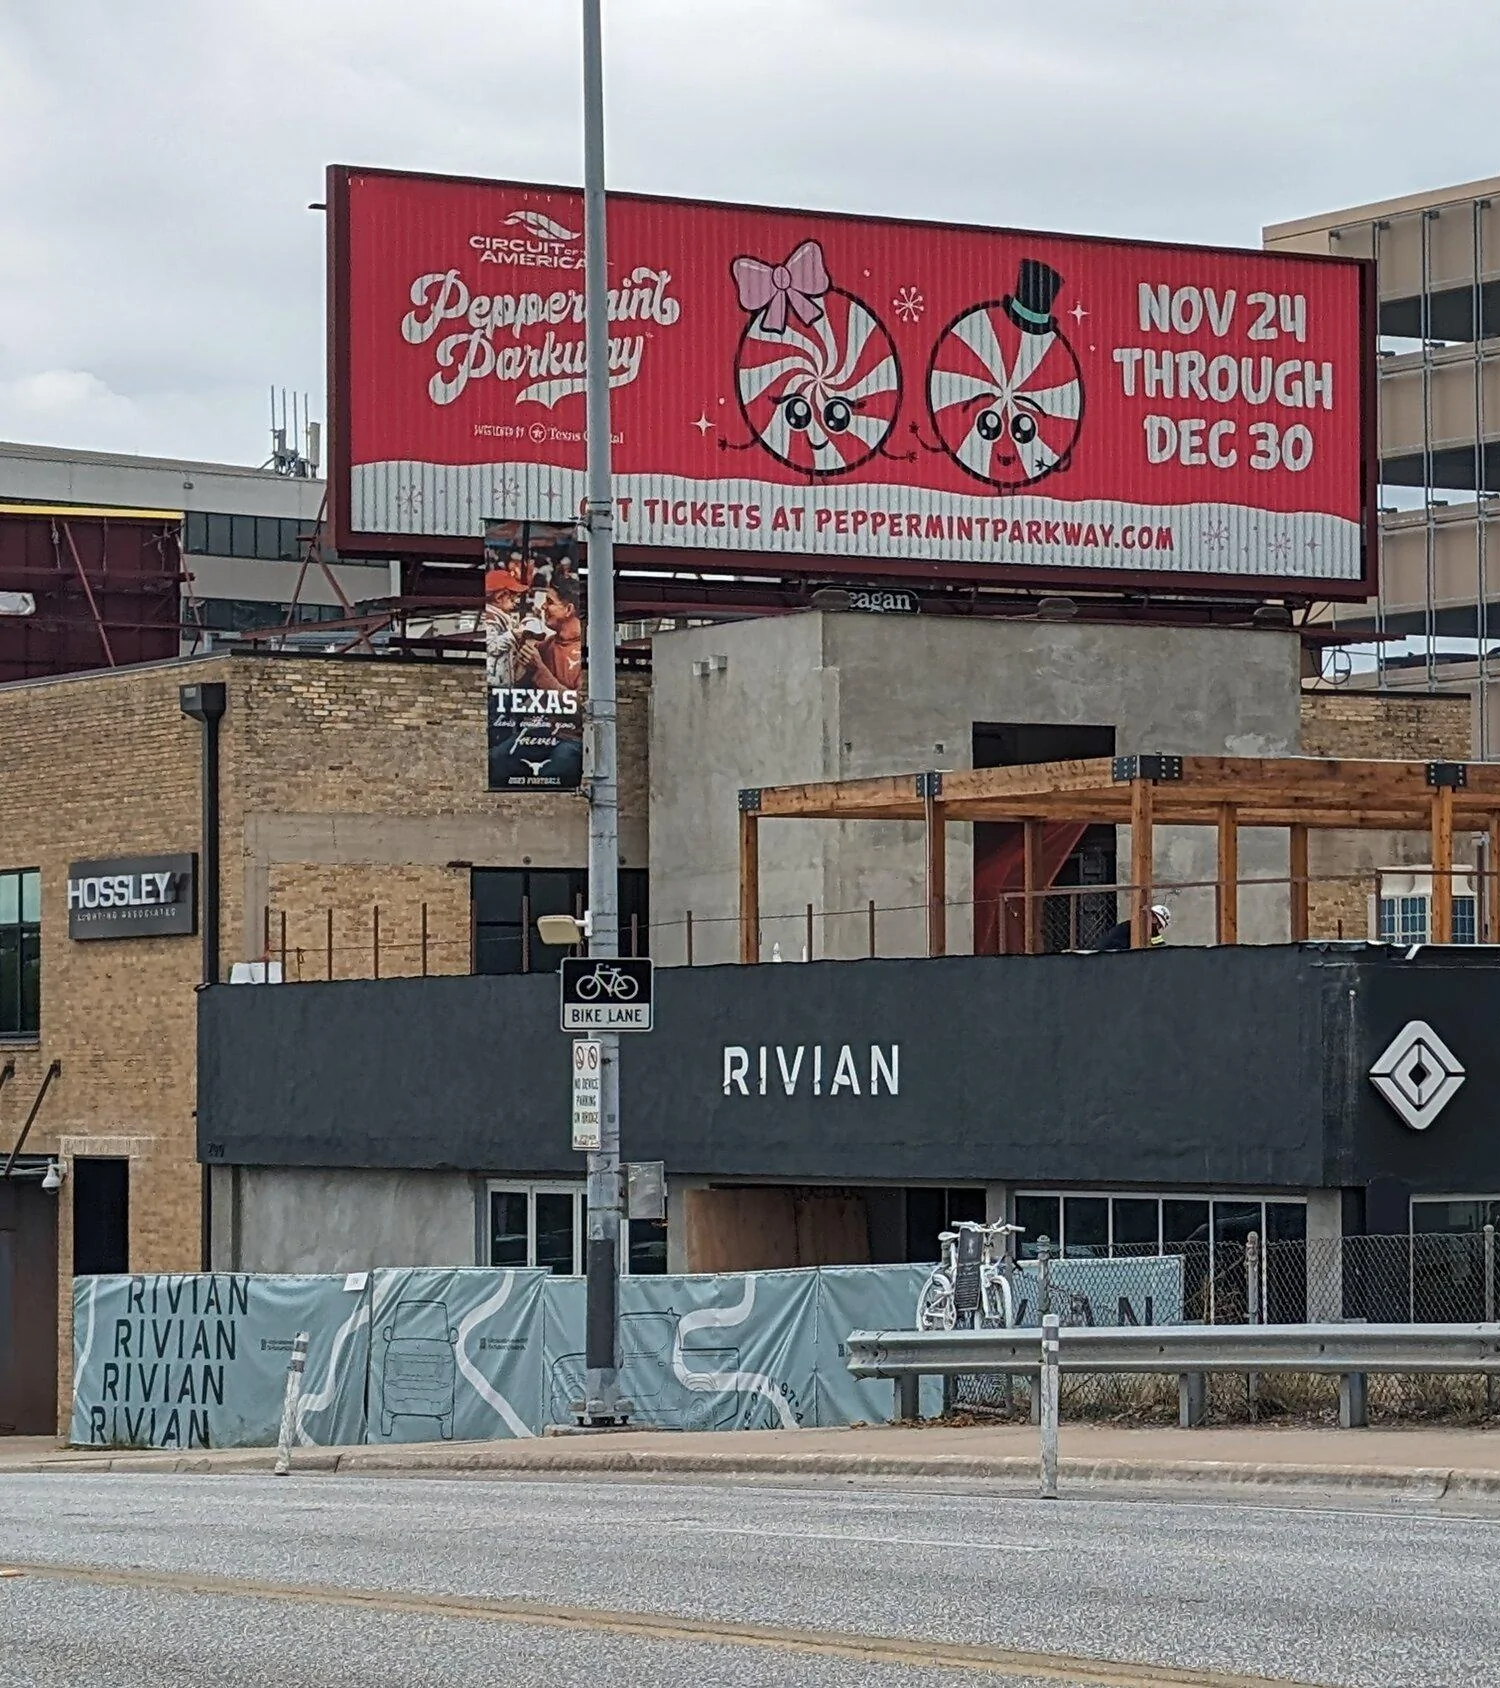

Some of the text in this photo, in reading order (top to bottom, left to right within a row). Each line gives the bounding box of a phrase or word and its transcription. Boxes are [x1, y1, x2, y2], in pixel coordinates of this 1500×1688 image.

[469, 235, 565, 255] CIRCUIT
[480, 250, 614, 269] AMERICA
[1138, 282, 1306, 342] NOV 24
[1112, 347, 1333, 410] THROUGH
[549, 427, 581, 441] Texas
[1143, 414, 1313, 472] DEC 30
[644, 498, 761, 530] TICKETS
[772, 505, 805, 532] AT
[815, 508, 1174, 551] PEPPERMINTPARKWAY.COM
[847, 590, 911, 612] eagan
[492, 688, 578, 714] TEXAS
[509, 727, 560, 755] forever
[67, 871, 172, 910] HOSSLEY
[572, 1008, 642, 1022] BIKE LANE
[723, 1044, 899, 1096] RIVIAN
[127, 1275, 250, 1315] RIVIAN
[114, 1319, 236, 1360] RIVIAN
[102, 1362, 224, 1406] RIVIAN
[90, 1405, 211, 1449] RIVIAN
